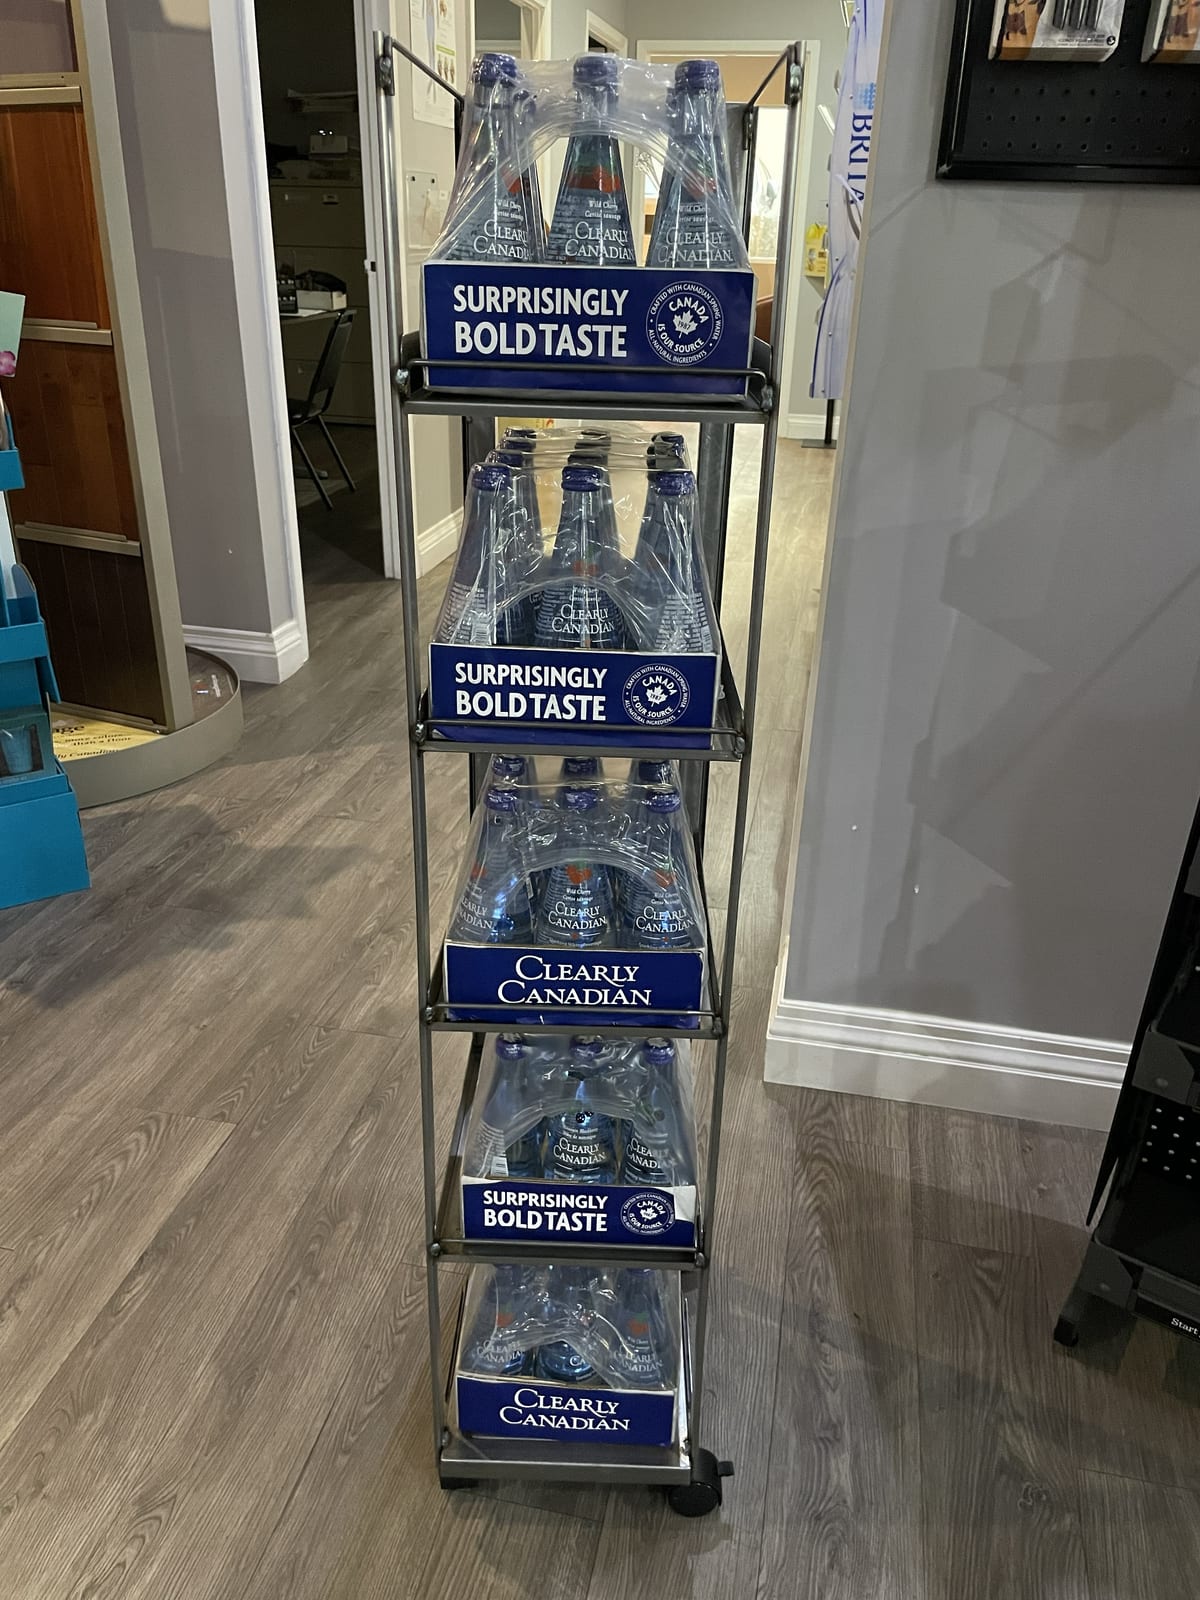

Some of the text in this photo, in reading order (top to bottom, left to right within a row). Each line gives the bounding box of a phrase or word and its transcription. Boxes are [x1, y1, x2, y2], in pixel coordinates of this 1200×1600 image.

[575, 221, 628, 246] CLEARLY
[565, 239, 635, 260] CANADIAN
[453, 284, 629, 316] SURPRISINGLY
[668, 296, 710, 324] CANADA
[650, 283, 721, 340] CRAFTED WITH CANADIAN SPRING WATER
[455, 321, 627, 357] BOLD TASTE
[657, 323, 705, 353] IS OUR SOURCE
[560, 603, 609, 622] CLEARLY
[551, 617, 616, 634] CANADIAN
[455, 662, 608, 688] SURPRISINGLY
[642, 675, 678, 696] CANADA
[456, 690, 606, 721] BOLD TASTE
[635, 702, 648, 716] OUR
[647, 706, 674, 718] SOURCE
[548, 910, 607, 930] CANADIAN
[555, 901, 600, 919] CLEARLY
[636, 916, 695, 933] CANADIAN
[515, 954, 640, 988] CLEARLY
[497, 979, 652, 1006] CANADIAN
[553, 1145, 607, 1165] CANADIAN
[560, 1137, 600, 1155] CLEARLY
[483, 1190, 608, 1210] SURPRISINGLY
[637, 1200, 666, 1215] CANADA
[484, 1208, 543, 1230] BOLD
[544, 1211, 608, 1231] TASTE
[1171, 1317, 1198, 1335] Start
[514, 1388, 619, 1418] CLEARLY
[500, 1406, 630, 1430] CANADIAN
